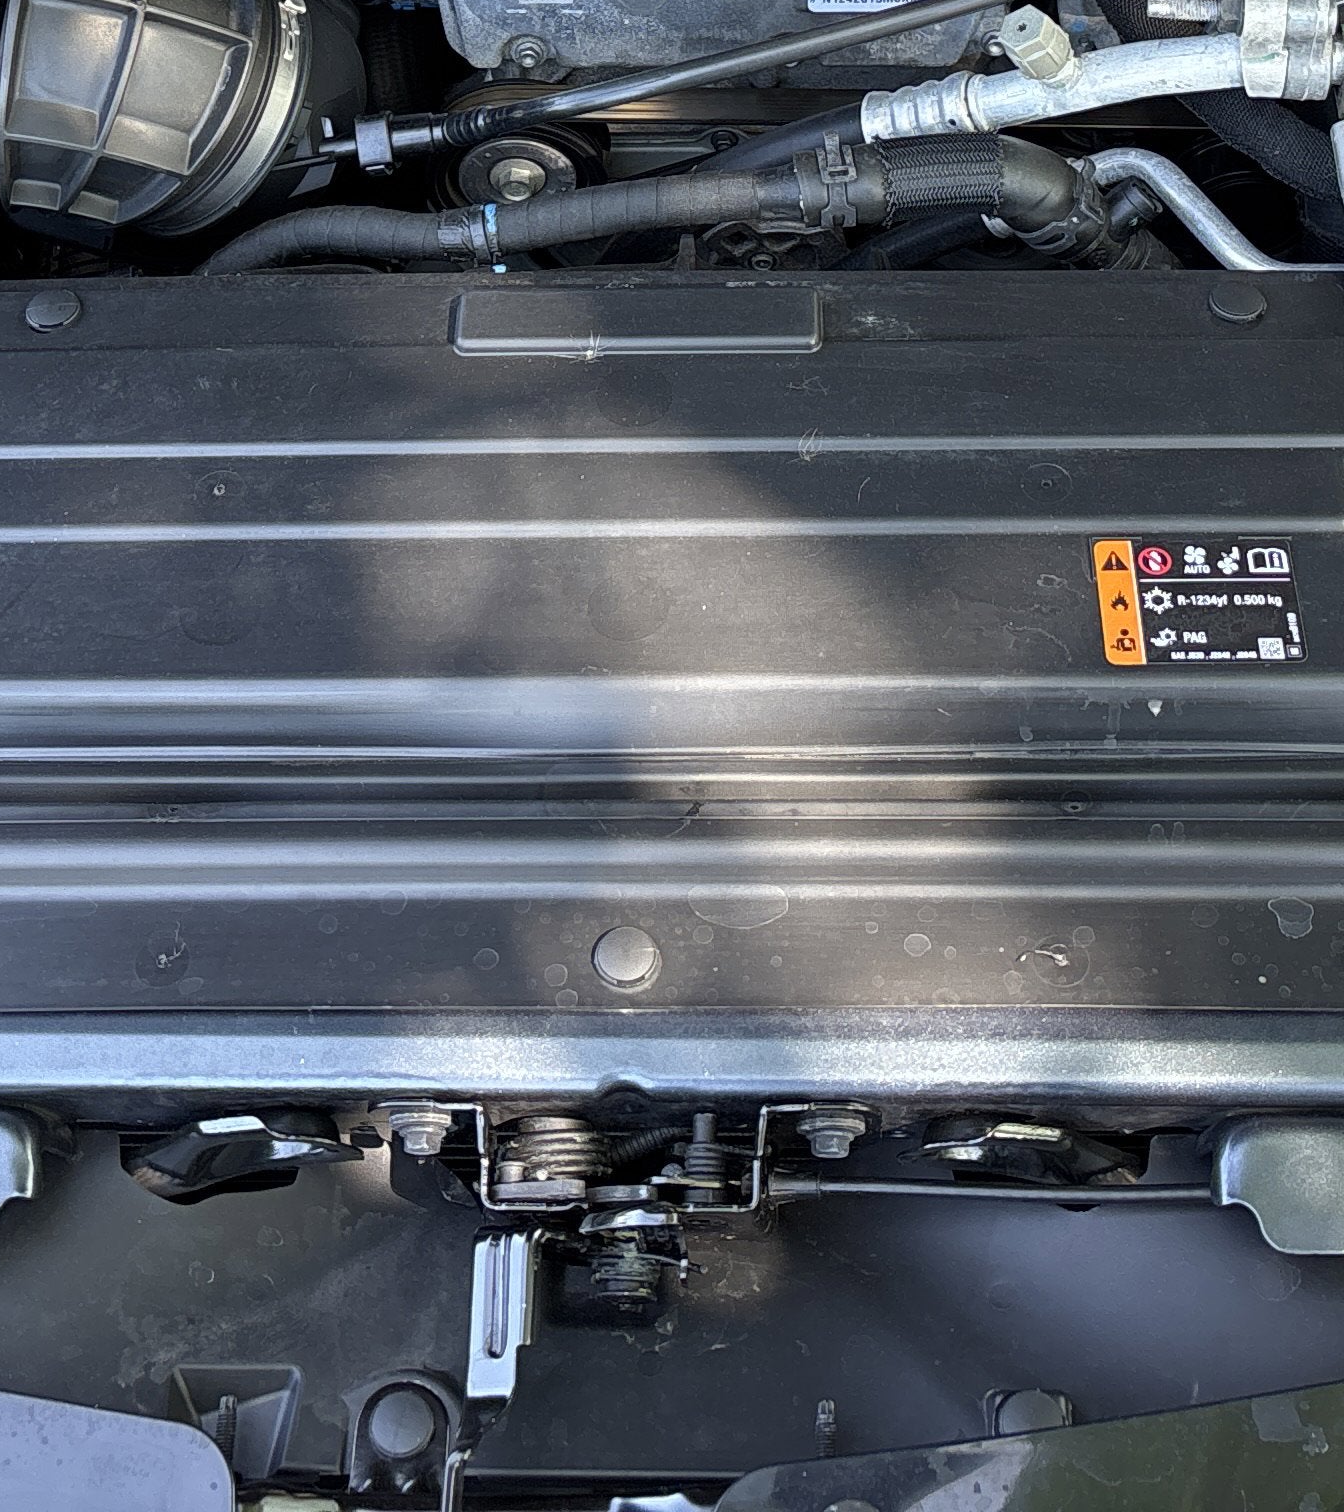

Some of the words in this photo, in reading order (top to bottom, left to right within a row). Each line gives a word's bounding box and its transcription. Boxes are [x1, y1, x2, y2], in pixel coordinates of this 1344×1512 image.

[1183, 565, 1211, 575] AUTO
[1177, 594, 1228, 607] R-1234yf
[1233, 594, 1266, 606] 0.500
[1268, 594, 1284, 608] kg
[1182, 631, 1208, 644] PAG
